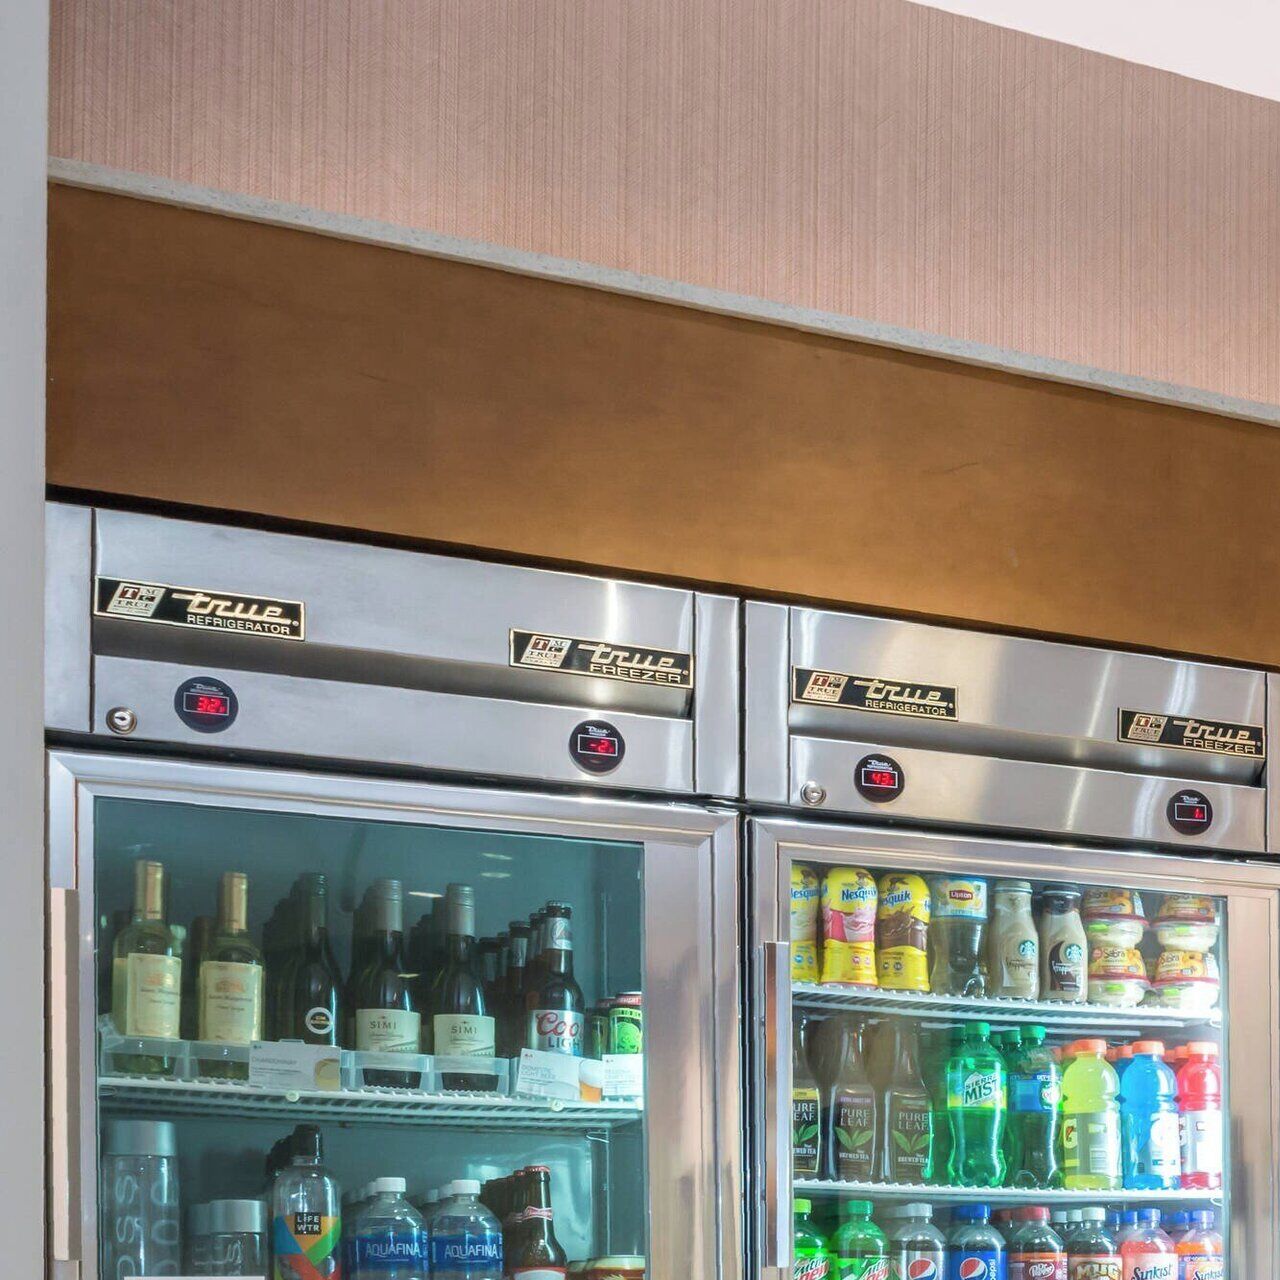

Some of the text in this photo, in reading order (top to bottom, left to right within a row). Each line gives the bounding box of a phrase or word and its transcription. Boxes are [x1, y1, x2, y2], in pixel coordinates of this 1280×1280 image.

[172, 592, 292, 625] true
[187, 614, 291, 635] REFRIGERATOR
[577, 643, 682, 674] true
[590, 663, 682, 684] FREEZER
[853, 679, 949, 708] true
[865, 699, 948, 717] REFRIGERATOR
[1173, 719, 1256, 746] true
[1183, 738, 1256, 755] FREEZER
[369, 1019, 399, 1031] SIMI
[451, 1024, 478, 1035] SIMI
[840, 1107, 871, 1119] PURE
[840, 1117, 869, 1127] LEAF
[899, 1112, 928, 1122] PURE
[296, 1223, 321, 1232] WTR
[364, 1241, 422, 1259] AQUAFINA
[443, 1241, 500, 1259] AQUAFINA
[1075, 1263, 1120, 1280] MUG
